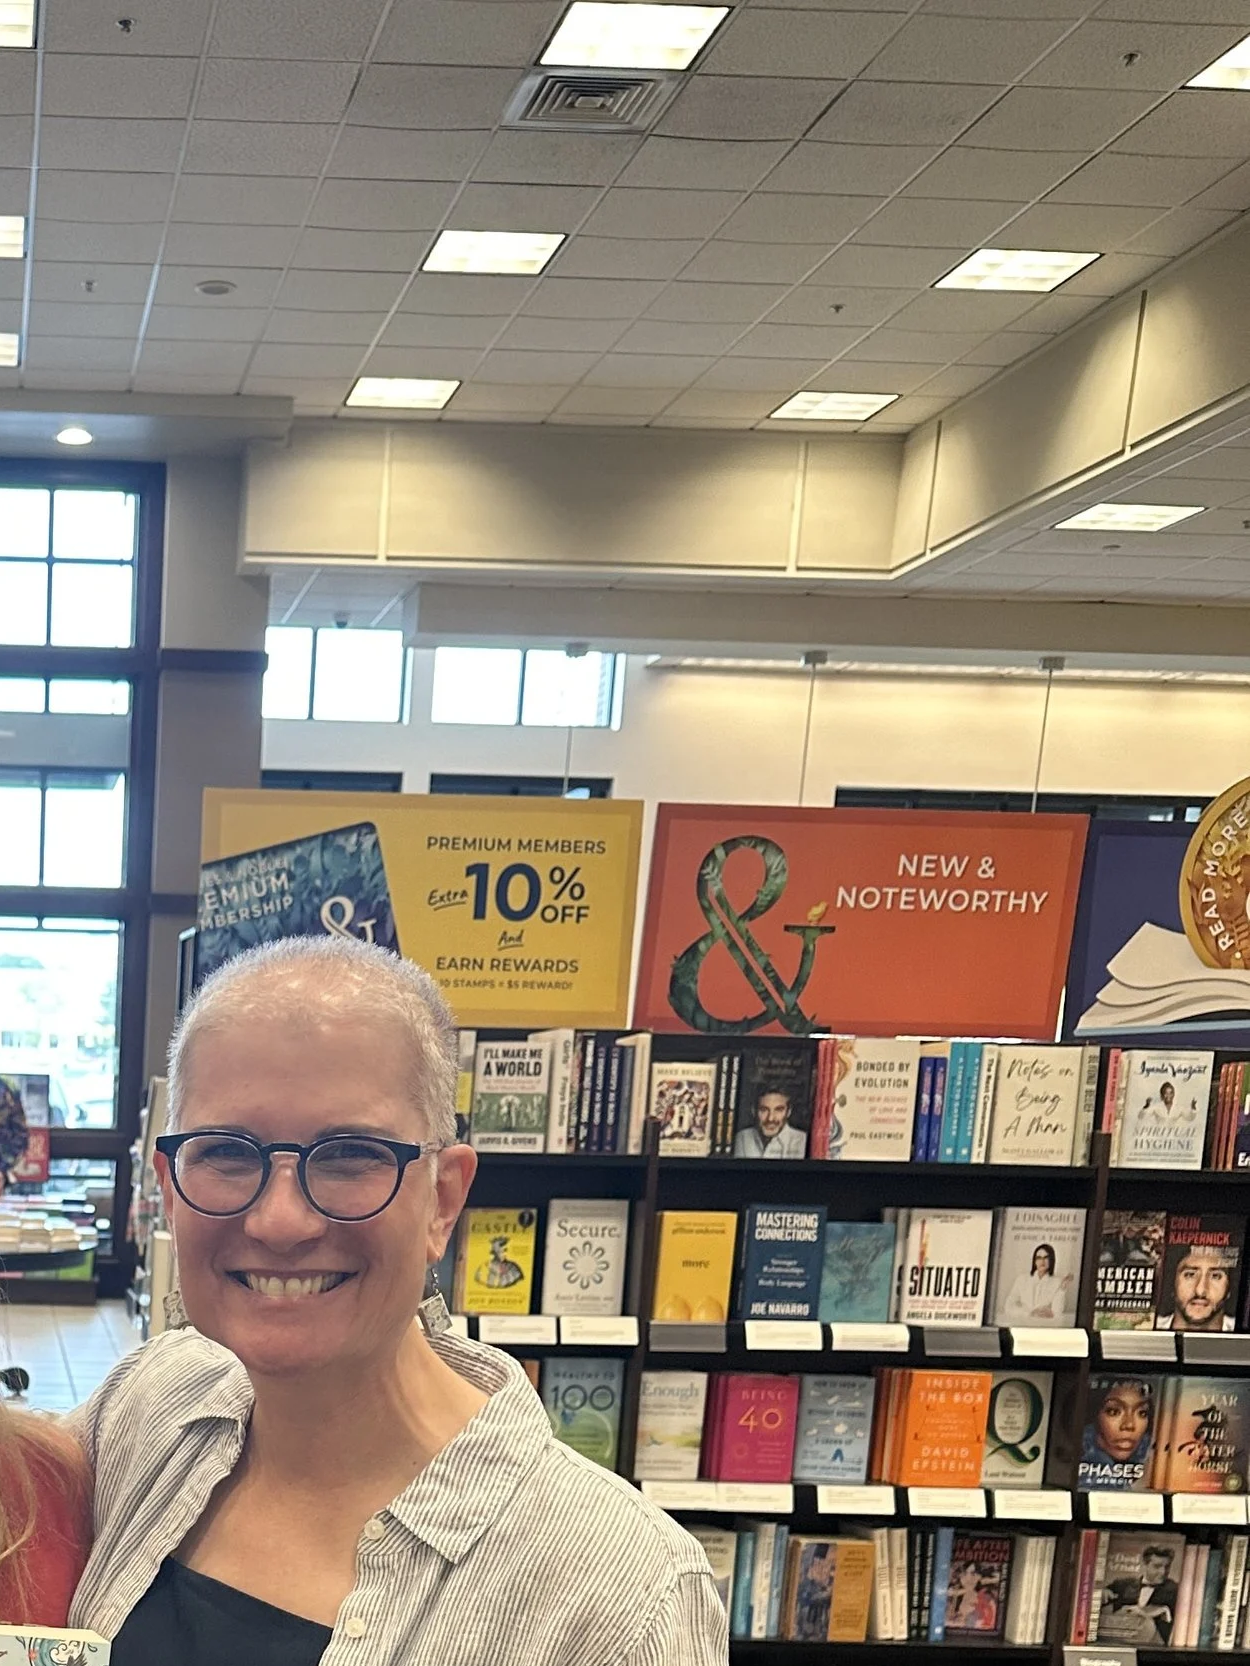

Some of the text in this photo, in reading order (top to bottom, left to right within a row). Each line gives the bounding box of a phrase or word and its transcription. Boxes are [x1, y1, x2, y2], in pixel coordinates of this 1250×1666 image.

[426, 836, 607, 854] PREMIUM MEMBERS
[897, 853, 996, 879] NEW &
[1202, 811, 1249, 952] READ MORE
[203, 872, 289, 910] EMIUM
[427, 887, 469, 907] Extra
[540, 904, 590, 924] OFF
[836, 885, 1049, 914] NOTEWORTHY
[200, 895, 294, 932] MBERSHIP
[497, 929, 525, 946] And
[435, 956, 579, 973] EARN REWARDS
[452, 979, 496, 989] STAMPS
[507, 980, 520, 990] $5
[502, 1048, 527, 1059] MAKE
[530, 1048, 543, 1059] ME
[483, 1061, 542, 1076] A WORLD
[856, 1061, 910, 1072] BONDED BY
[854, 1078, 909, 1088] EVOLUTION
[1134, 1138, 1194, 1150] HYGIENE
[756, 1212, 819, 1228] MASTERING
[1170, 1217, 1202, 1229] COLIN
[755, 1228, 819, 1243] CONNECTIONS
[1168, 1232, 1230, 1245] KAEPERNICK
[682, 1260, 710, 1269] more
[1097, 1267, 1155, 1280] MERICAN
[908, 1265, 981, 1298] SITUATED
[1097, 1281, 1153, 1294] MBLER
[750, 1302, 810, 1316] JOE NAVARRO
[642, 1380, 700, 1400] Enough
[926, 1378, 980, 1390] INSIDE
[550, 1384, 615, 1411] 100
[741, 1389, 786, 1401] BEING
[918, 1392, 984, 1404] THE BOX
[738, 1405, 783, 1434] 40
[921, 1447, 970, 1458] DAVID
[912, 1460, 975, 1472] EPSTEIN
[1078, 1462, 1144, 1479] PHASES
[973, 1540, 1010, 1550] AFTER
[954, 1550, 1010, 1562] MBITION
